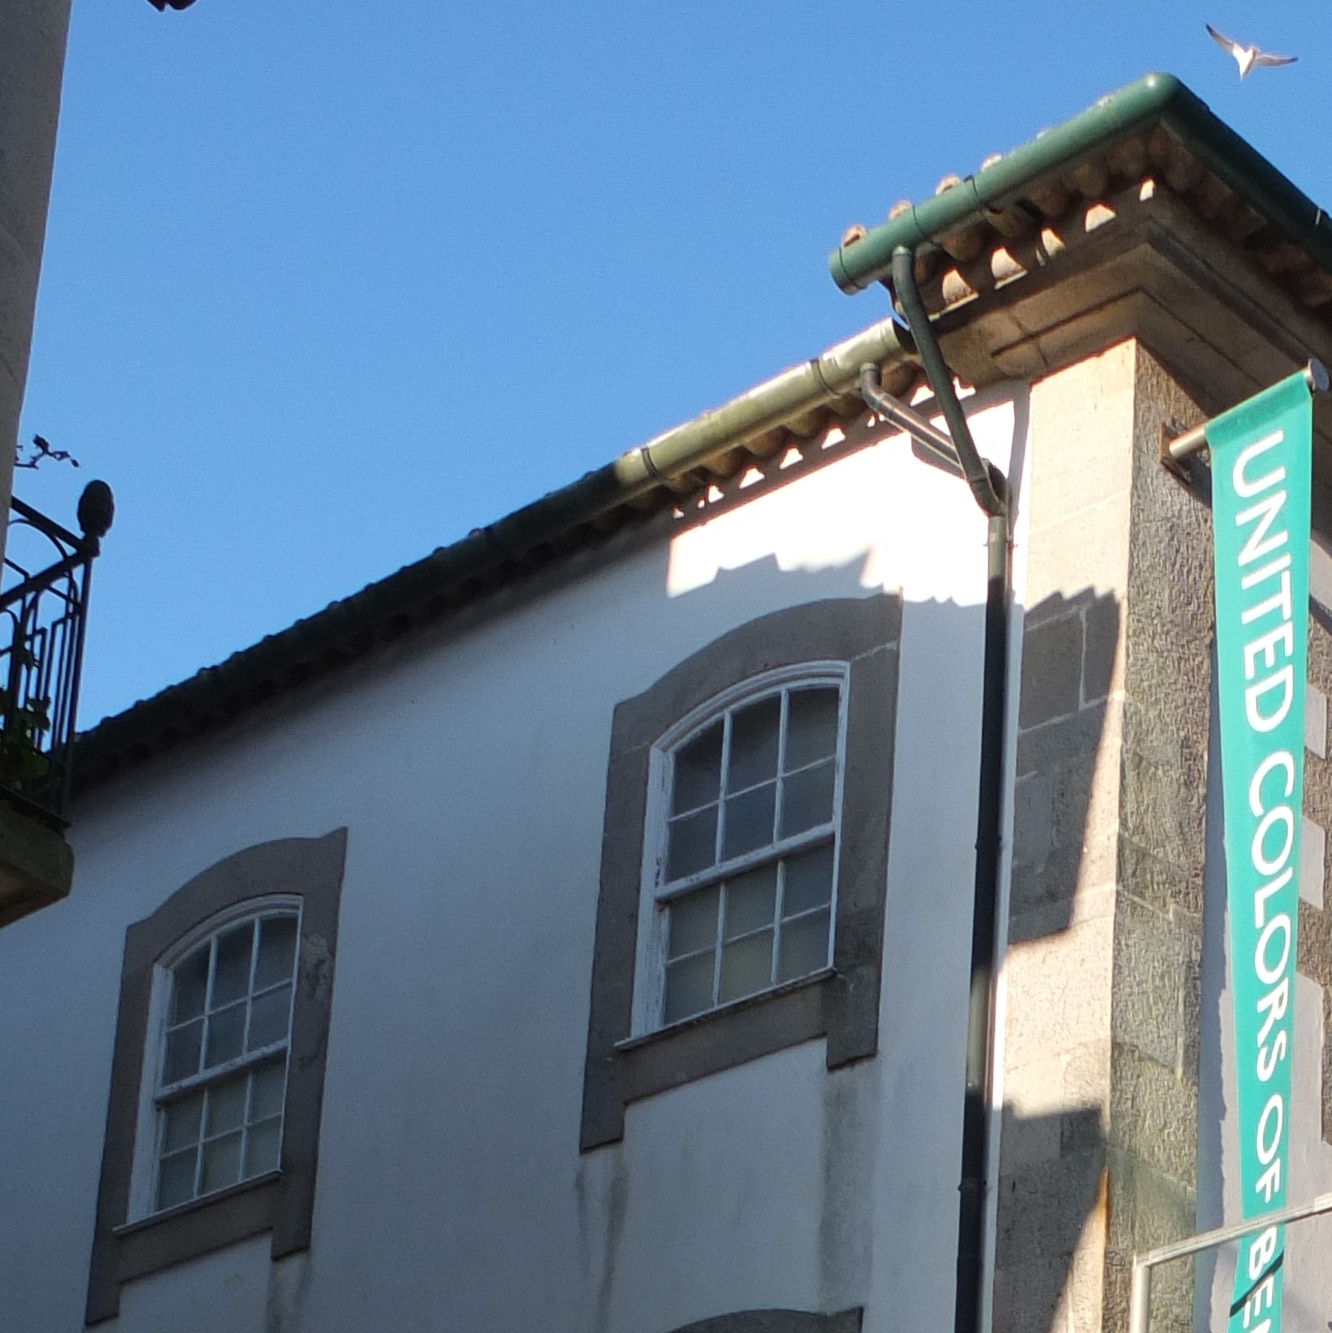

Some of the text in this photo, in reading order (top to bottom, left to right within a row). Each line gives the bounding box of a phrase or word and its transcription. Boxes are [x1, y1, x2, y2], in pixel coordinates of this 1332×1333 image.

[1232, 429, 1294, 732] UNITED
[1249, 750, 1294, 1082] COLORS
[1255, 1094, 1283, 1203] OF
